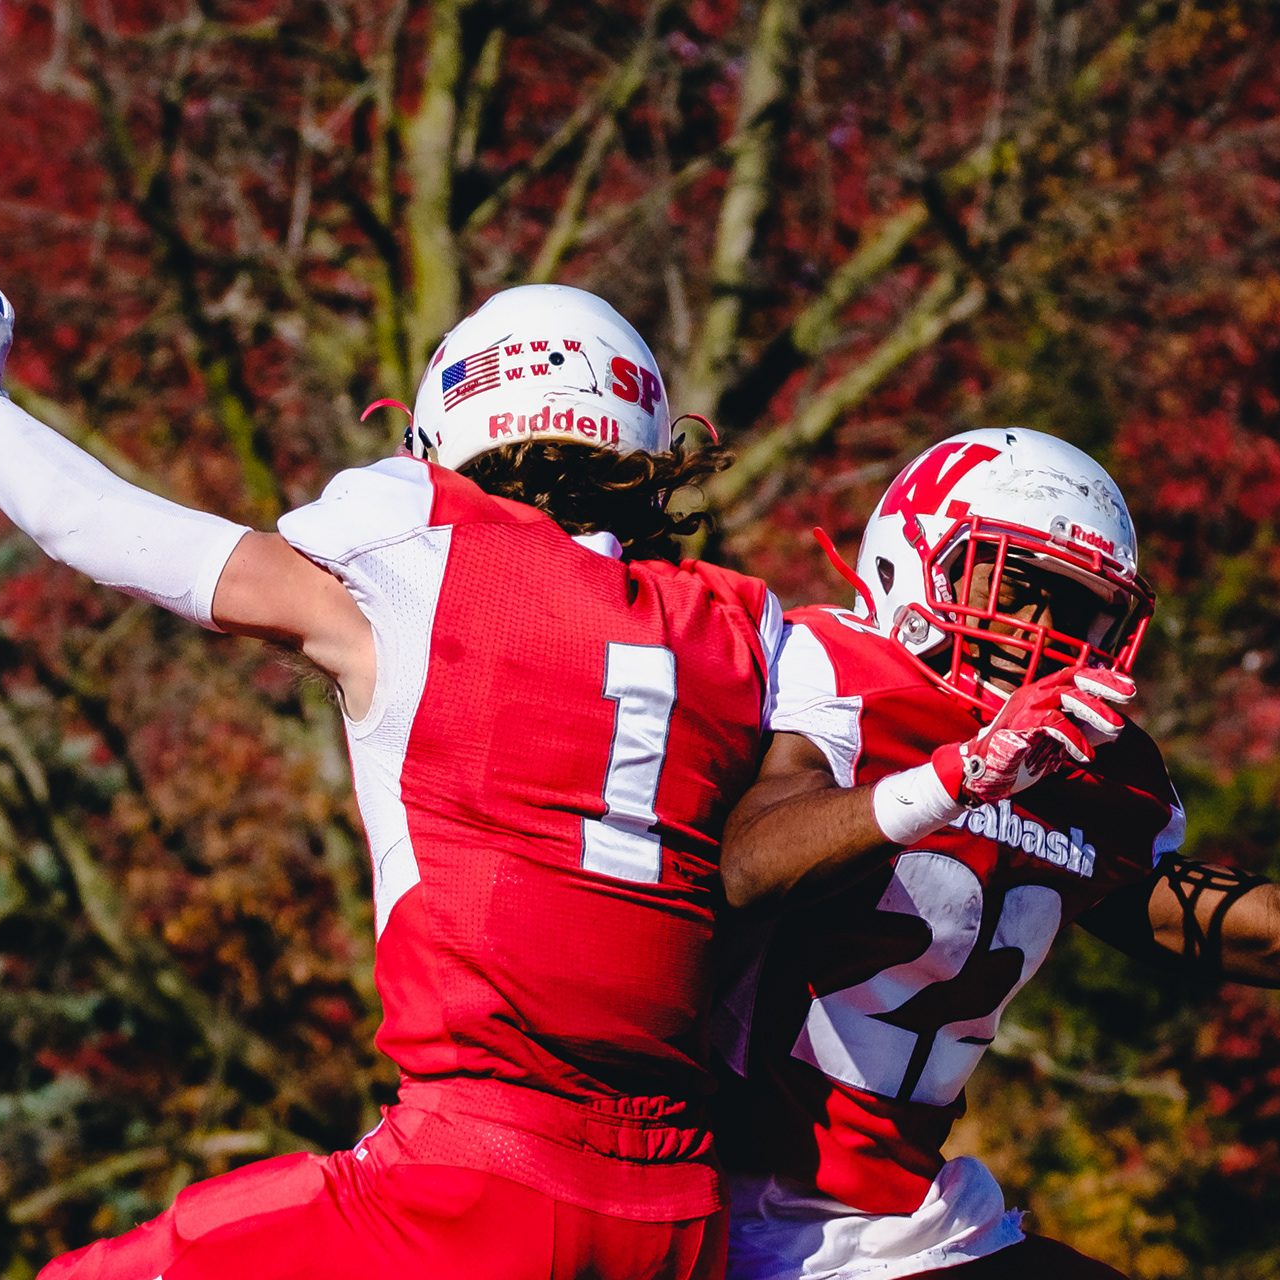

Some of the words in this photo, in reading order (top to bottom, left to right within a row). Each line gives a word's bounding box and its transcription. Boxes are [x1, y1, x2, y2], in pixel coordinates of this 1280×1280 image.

[610, 356, 662, 416] SP
[488, 405, 620, 445] Riddell
[1070, 524, 1115, 556] Riddell
[579, 641, 677, 884] 1
[948, 798, 1096, 878] abash
[790, 850, 1063, 1107] 22
